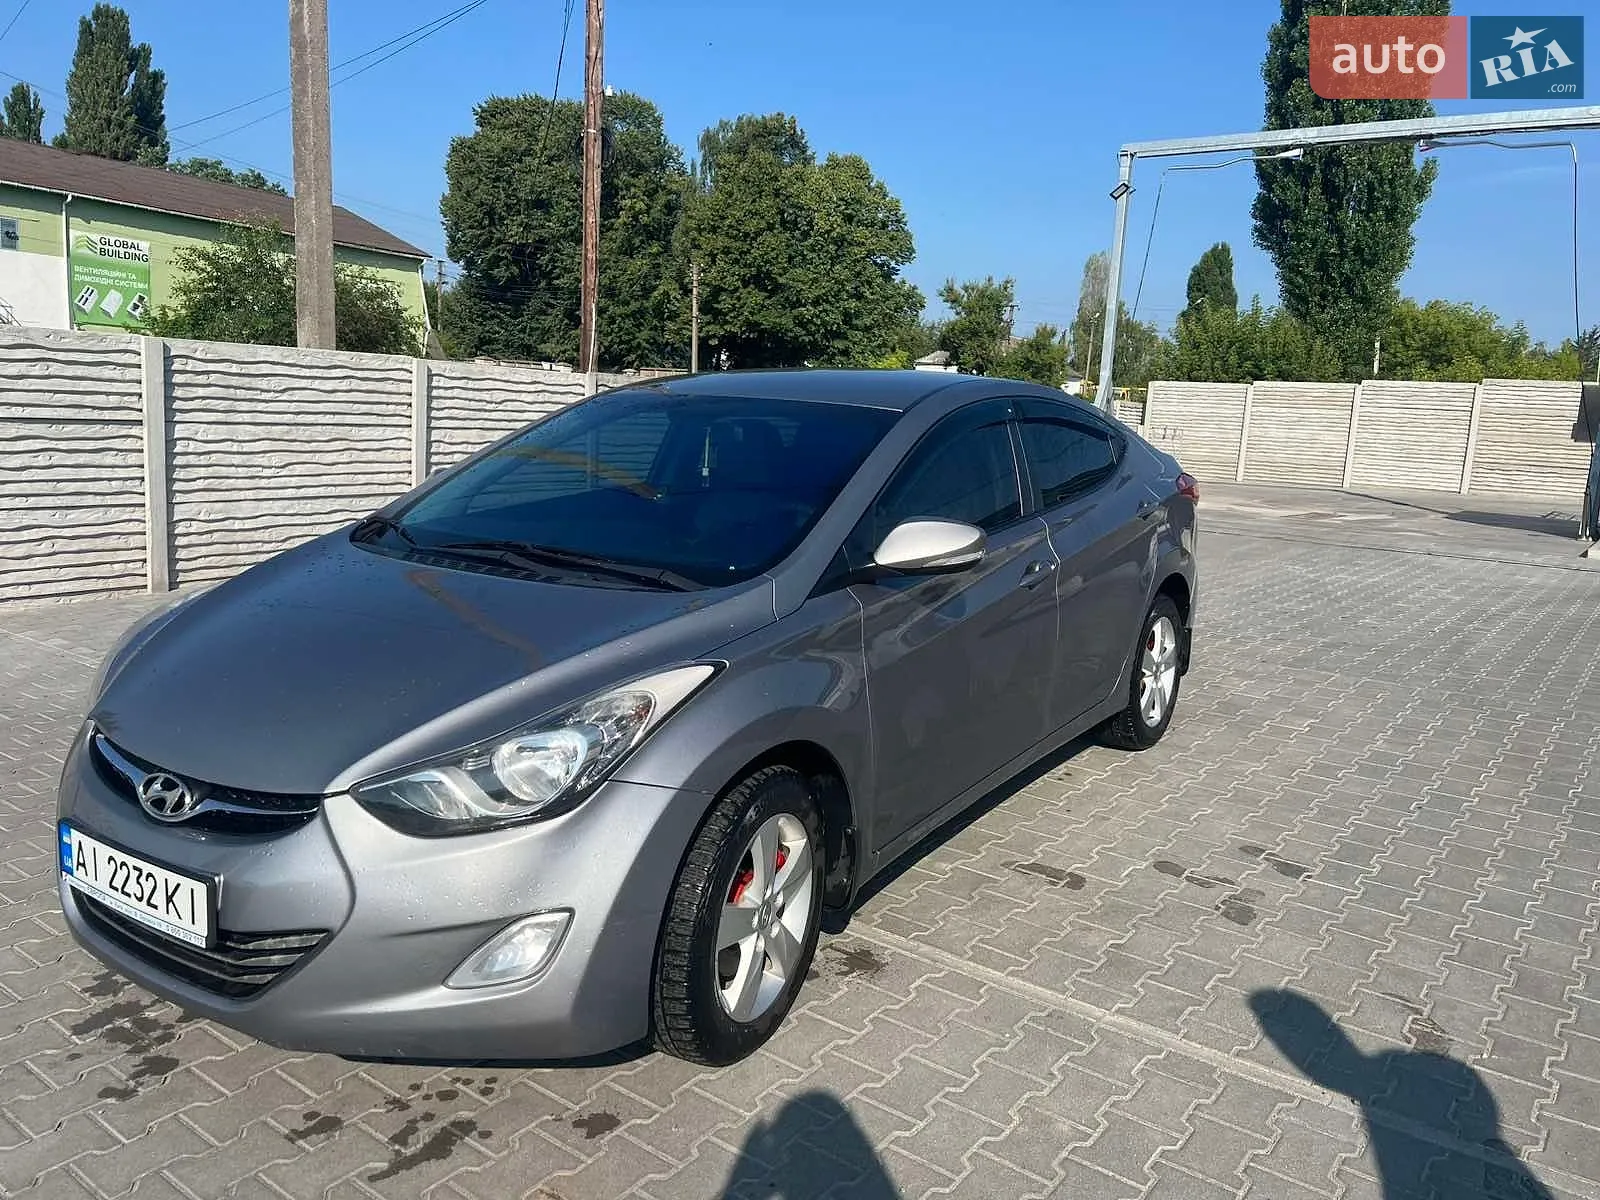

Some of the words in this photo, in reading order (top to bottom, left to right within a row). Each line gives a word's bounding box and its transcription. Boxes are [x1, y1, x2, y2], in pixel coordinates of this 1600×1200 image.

[99, 236, 143, 252] GLOBAL
[99, 247, 149, 263] BUILDING
[128, 272, 137, 281] ТА
[63, 855, 73, 868] UA
[76, 840, 98, 882] AI
[107, 855, 159, 910] 2232
[165, 877, 195, 925] KI
